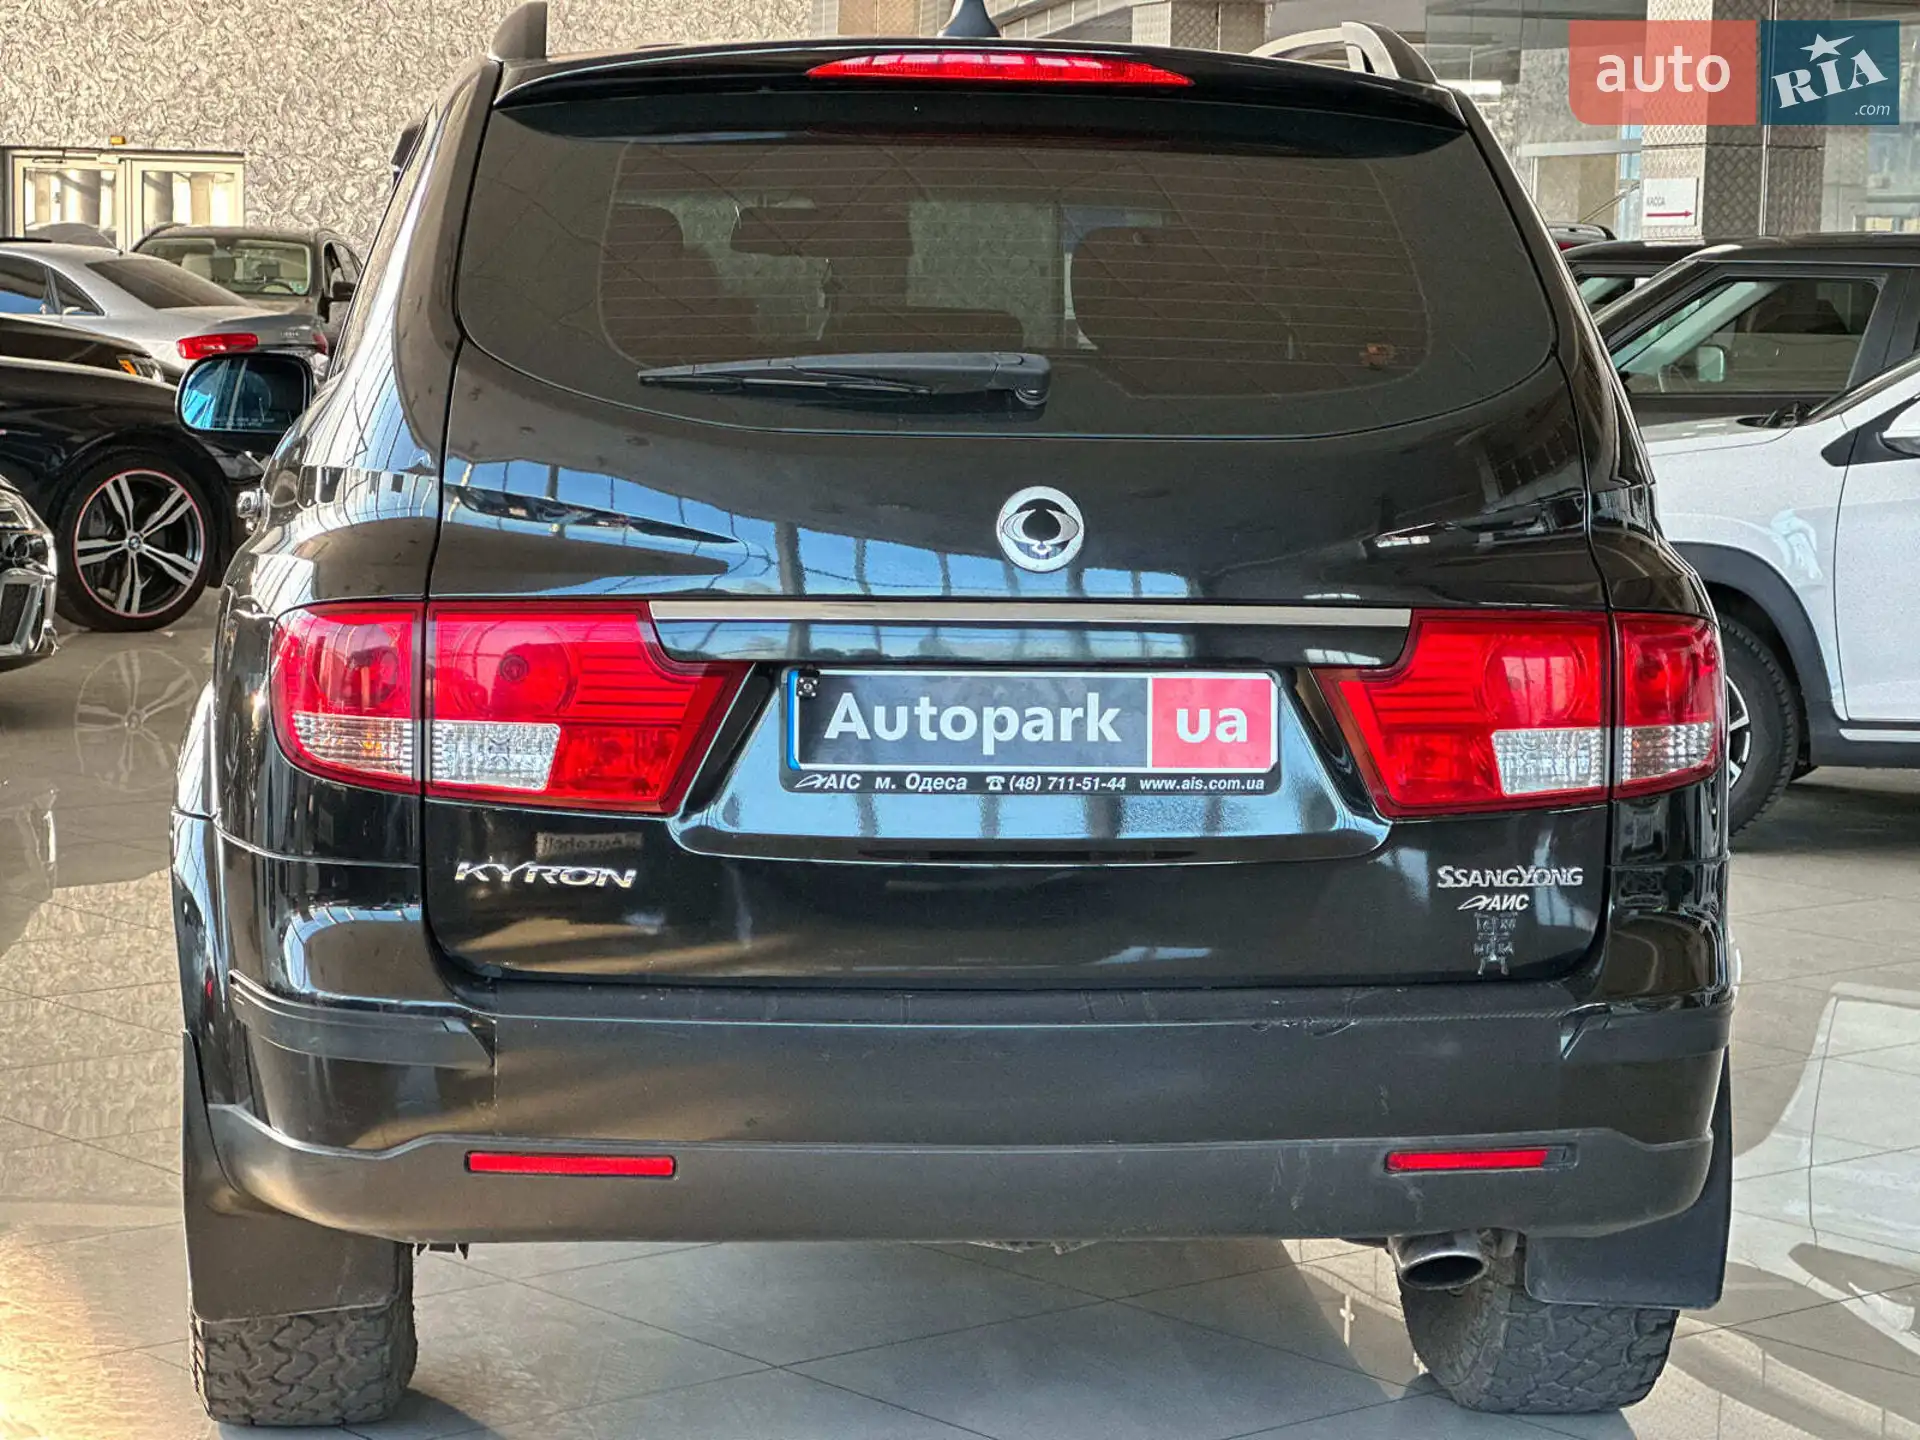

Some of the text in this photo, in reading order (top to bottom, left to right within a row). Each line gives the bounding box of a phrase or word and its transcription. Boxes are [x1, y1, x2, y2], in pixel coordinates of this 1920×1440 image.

[824, 692, 1248, 755] Autopark ua
[875, 776, 897, 789] м.
[905, 772, 968, 793] Одеса
[1009, 775, 1042, 791] (48)
[1047, 776, 1127, 790] 711-51-44
[1139, 776, 1265, 790] www.ais.com.ua
[454, 861, 637, 888] KYRON
[1436, 865, 1584, 888] SSANGYONG
[1487, 894, 1530, 911] АИС
